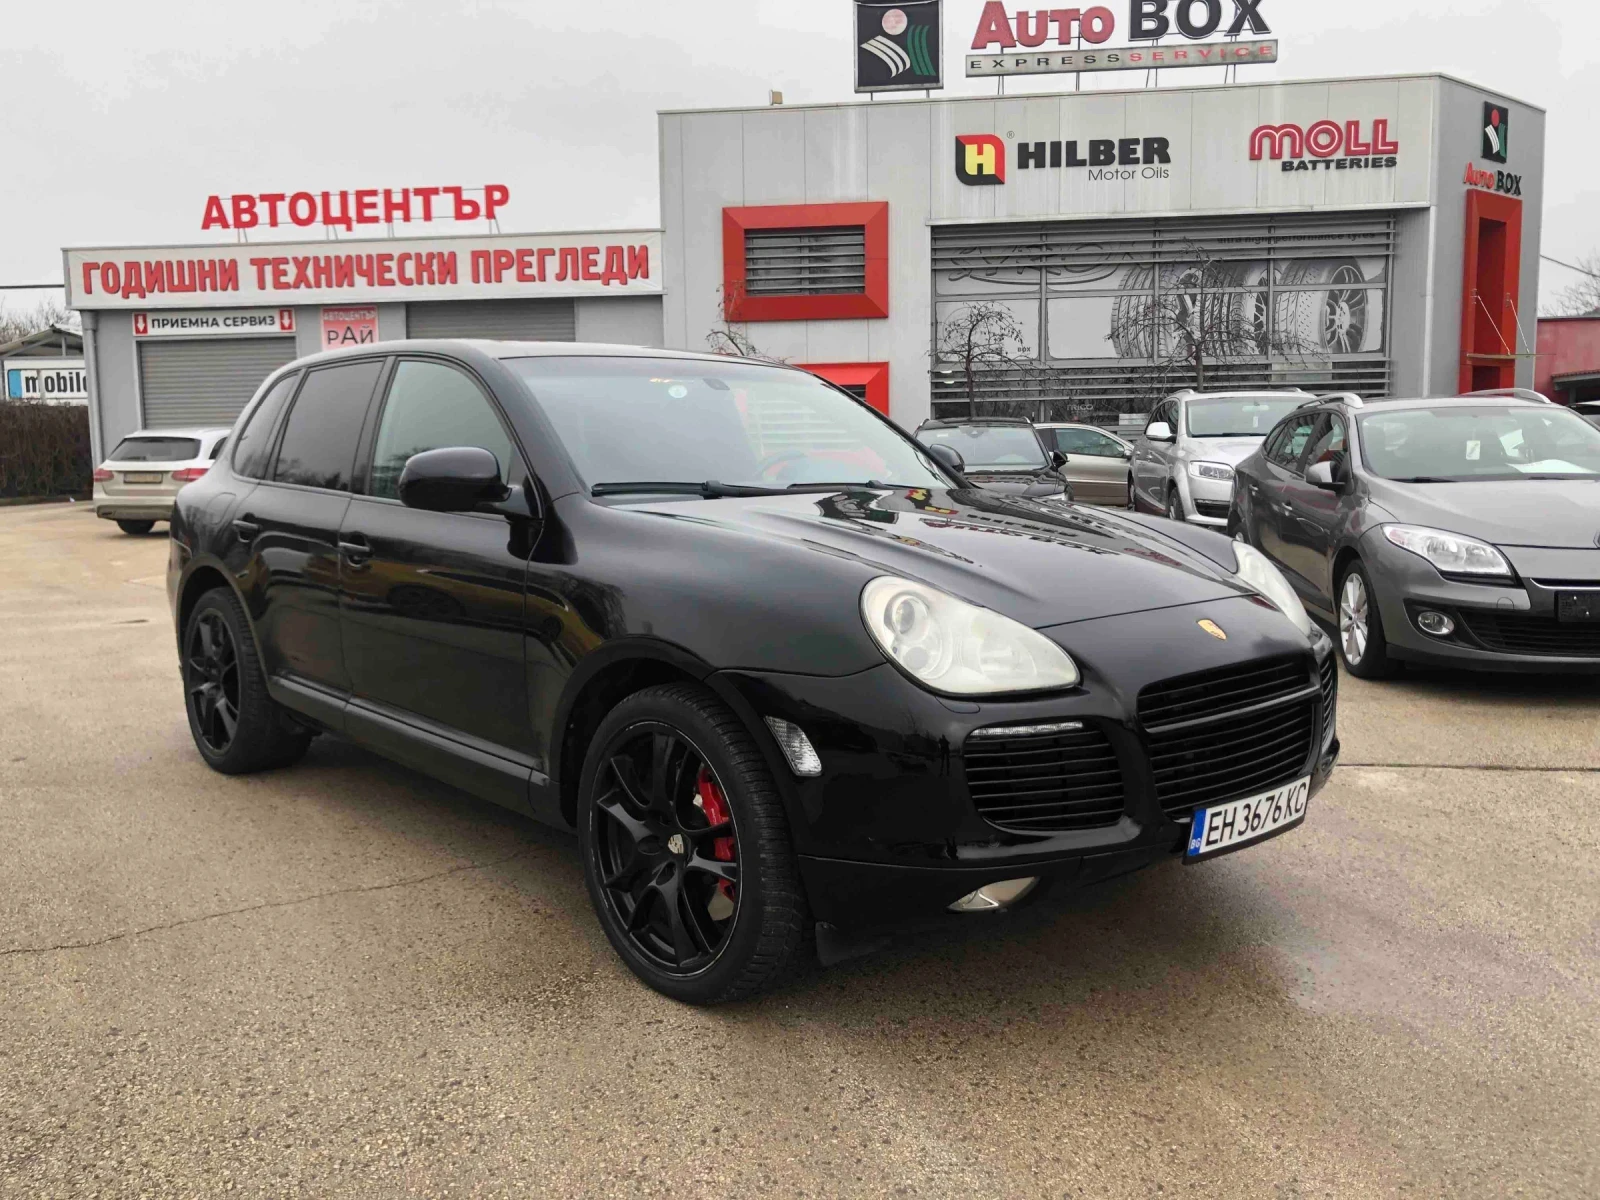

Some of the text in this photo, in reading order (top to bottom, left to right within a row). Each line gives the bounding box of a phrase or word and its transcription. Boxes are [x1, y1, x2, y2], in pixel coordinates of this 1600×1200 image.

[1128, 0, 1272, 41] BOX
[1017, 136, 1172, 170] HILBER
[1281, 156, 1398, 172] BATTERIES
[1088, 166, 1170, 182] Motor Oils
[1495, 169, 1522, 196] BOX
[201, 184, 510, 232] АВТОЦЕНТЪР
[82, 244, 649, 300] ГОДИШНИ ТЕХНИЧЕСКИ ПРЕГЛЕДИ
[151, 315, 276, 329] ПРИЕМНА СЕРВИЗ
[327, 324, 374, 345] РАЙ
